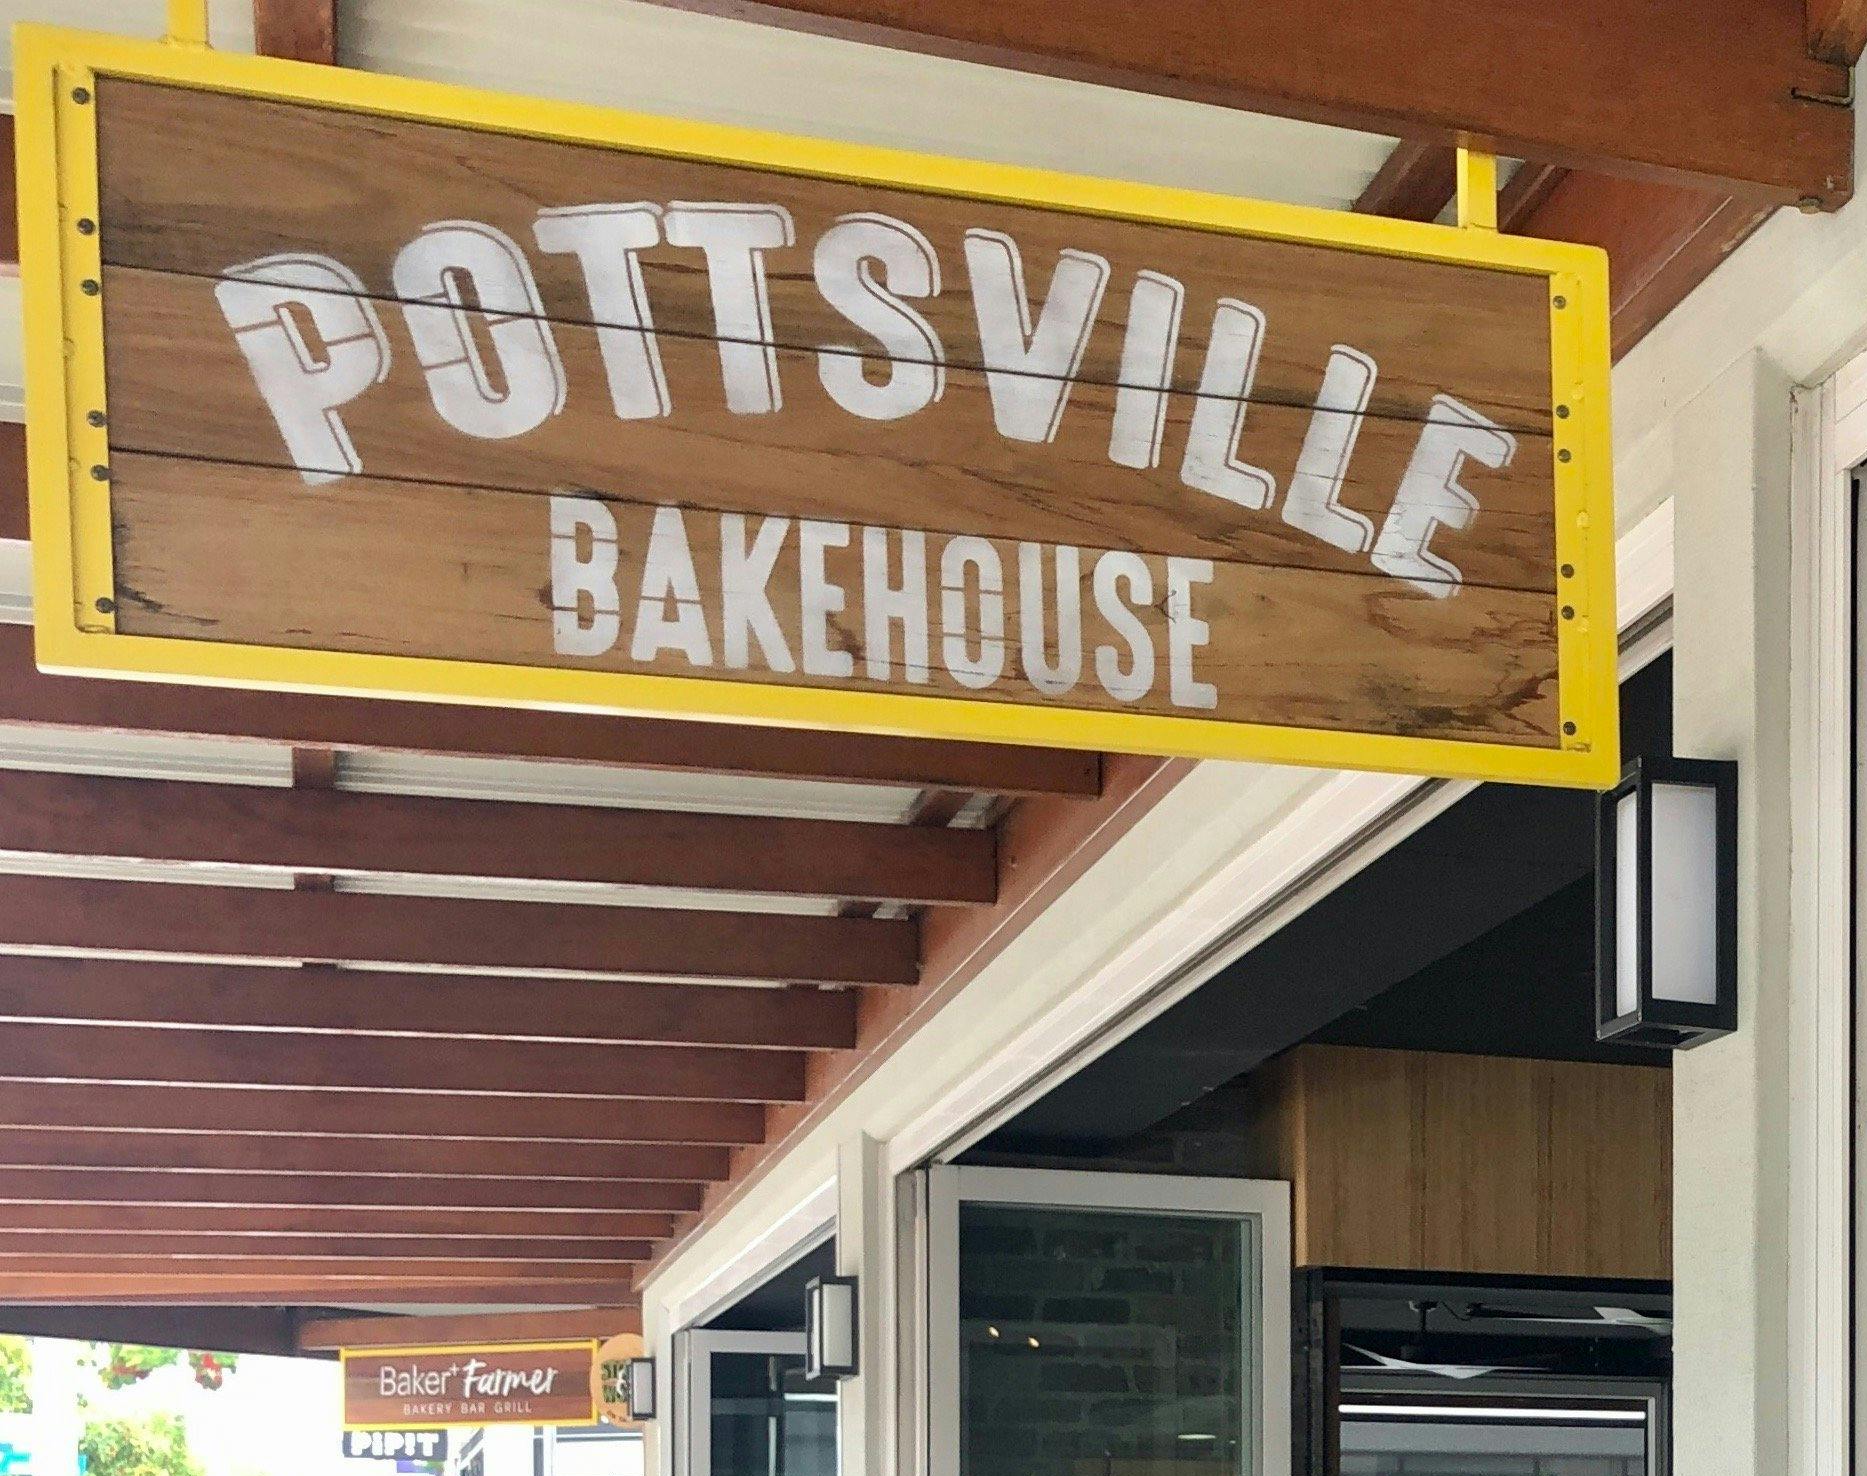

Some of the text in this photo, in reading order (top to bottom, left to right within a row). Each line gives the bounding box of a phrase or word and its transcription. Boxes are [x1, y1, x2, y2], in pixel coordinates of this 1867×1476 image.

[214, 199, 1517, 599] POTTSVILLE
[549, 488, 1217, 709] BAKEHOUSE
[403, 1400, 533, 1416] BAKERY BAR GRILL
[462, 1358, 559, 1398] Farmer
